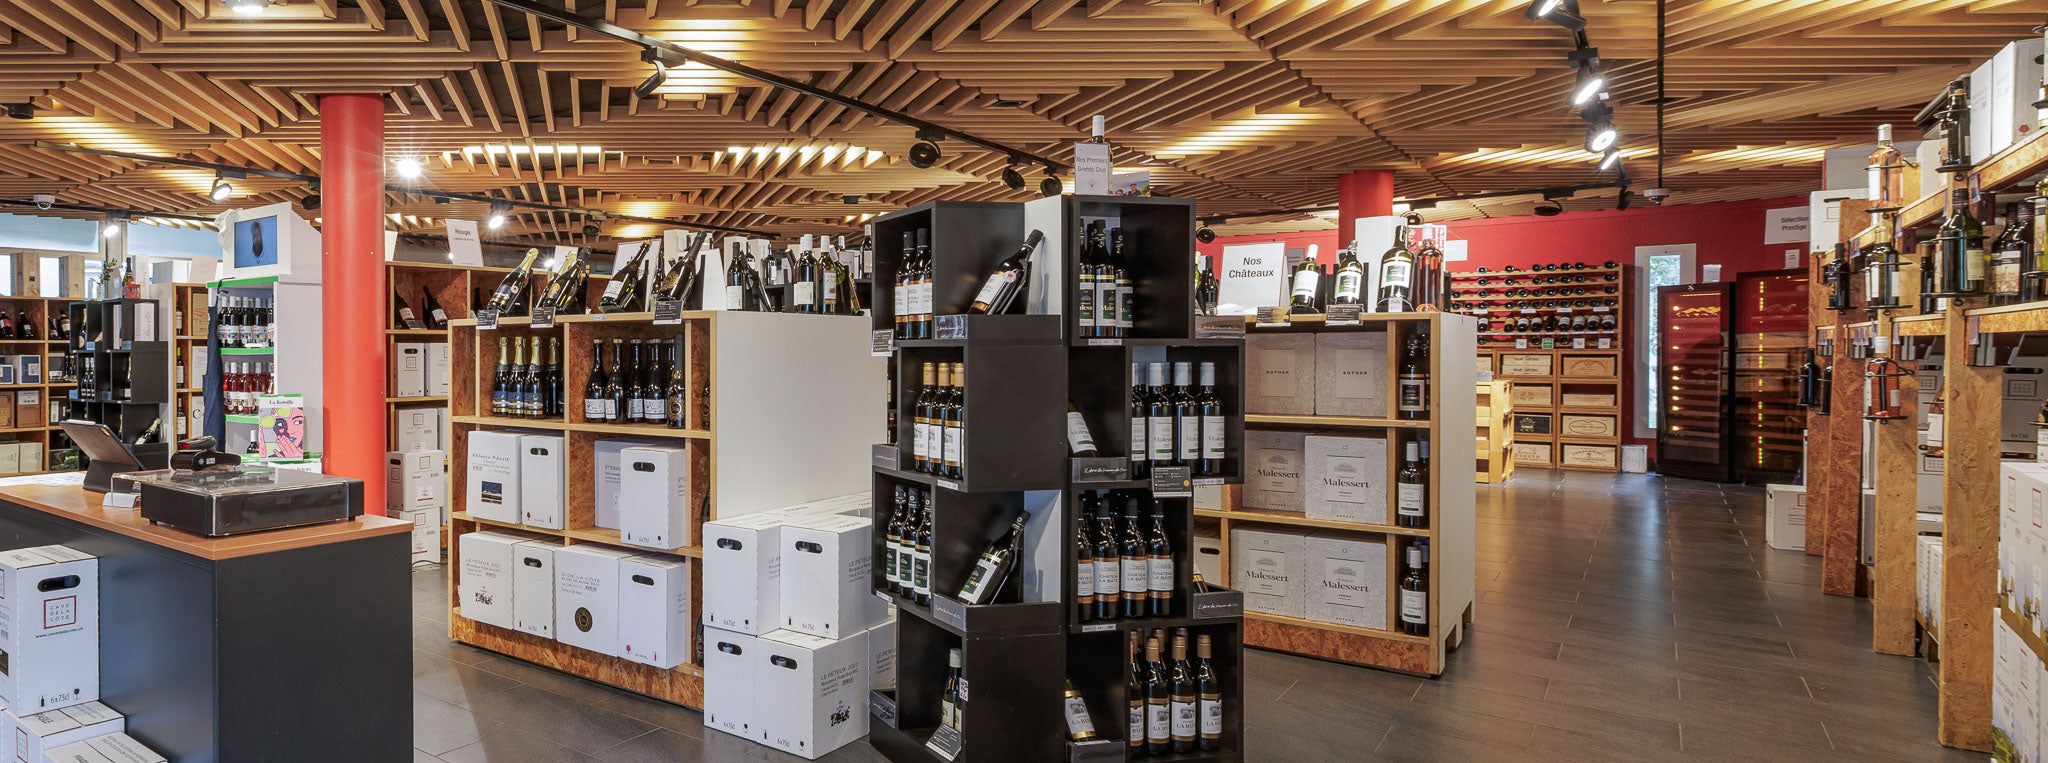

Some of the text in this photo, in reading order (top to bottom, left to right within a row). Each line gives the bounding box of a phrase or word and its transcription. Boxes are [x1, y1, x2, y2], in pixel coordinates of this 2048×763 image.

[1780, 215, 1809, 224] Sélection
[454, 228, 471, 237] Rouge
[1781, 224, 1807, 232] Prestige
[1242, 257, 1262, 266] Nos
[1228, 268, 1274, 279] Châteaux
[1257, 469, 1300, 479] Malessert
[1322, 478, 1371, 489] Malessert
[1246, 570, 1289, 582] Malessert
[1321, 580, 1369, 593] Malessert
[50, 614, 69, 622] CÔTE
